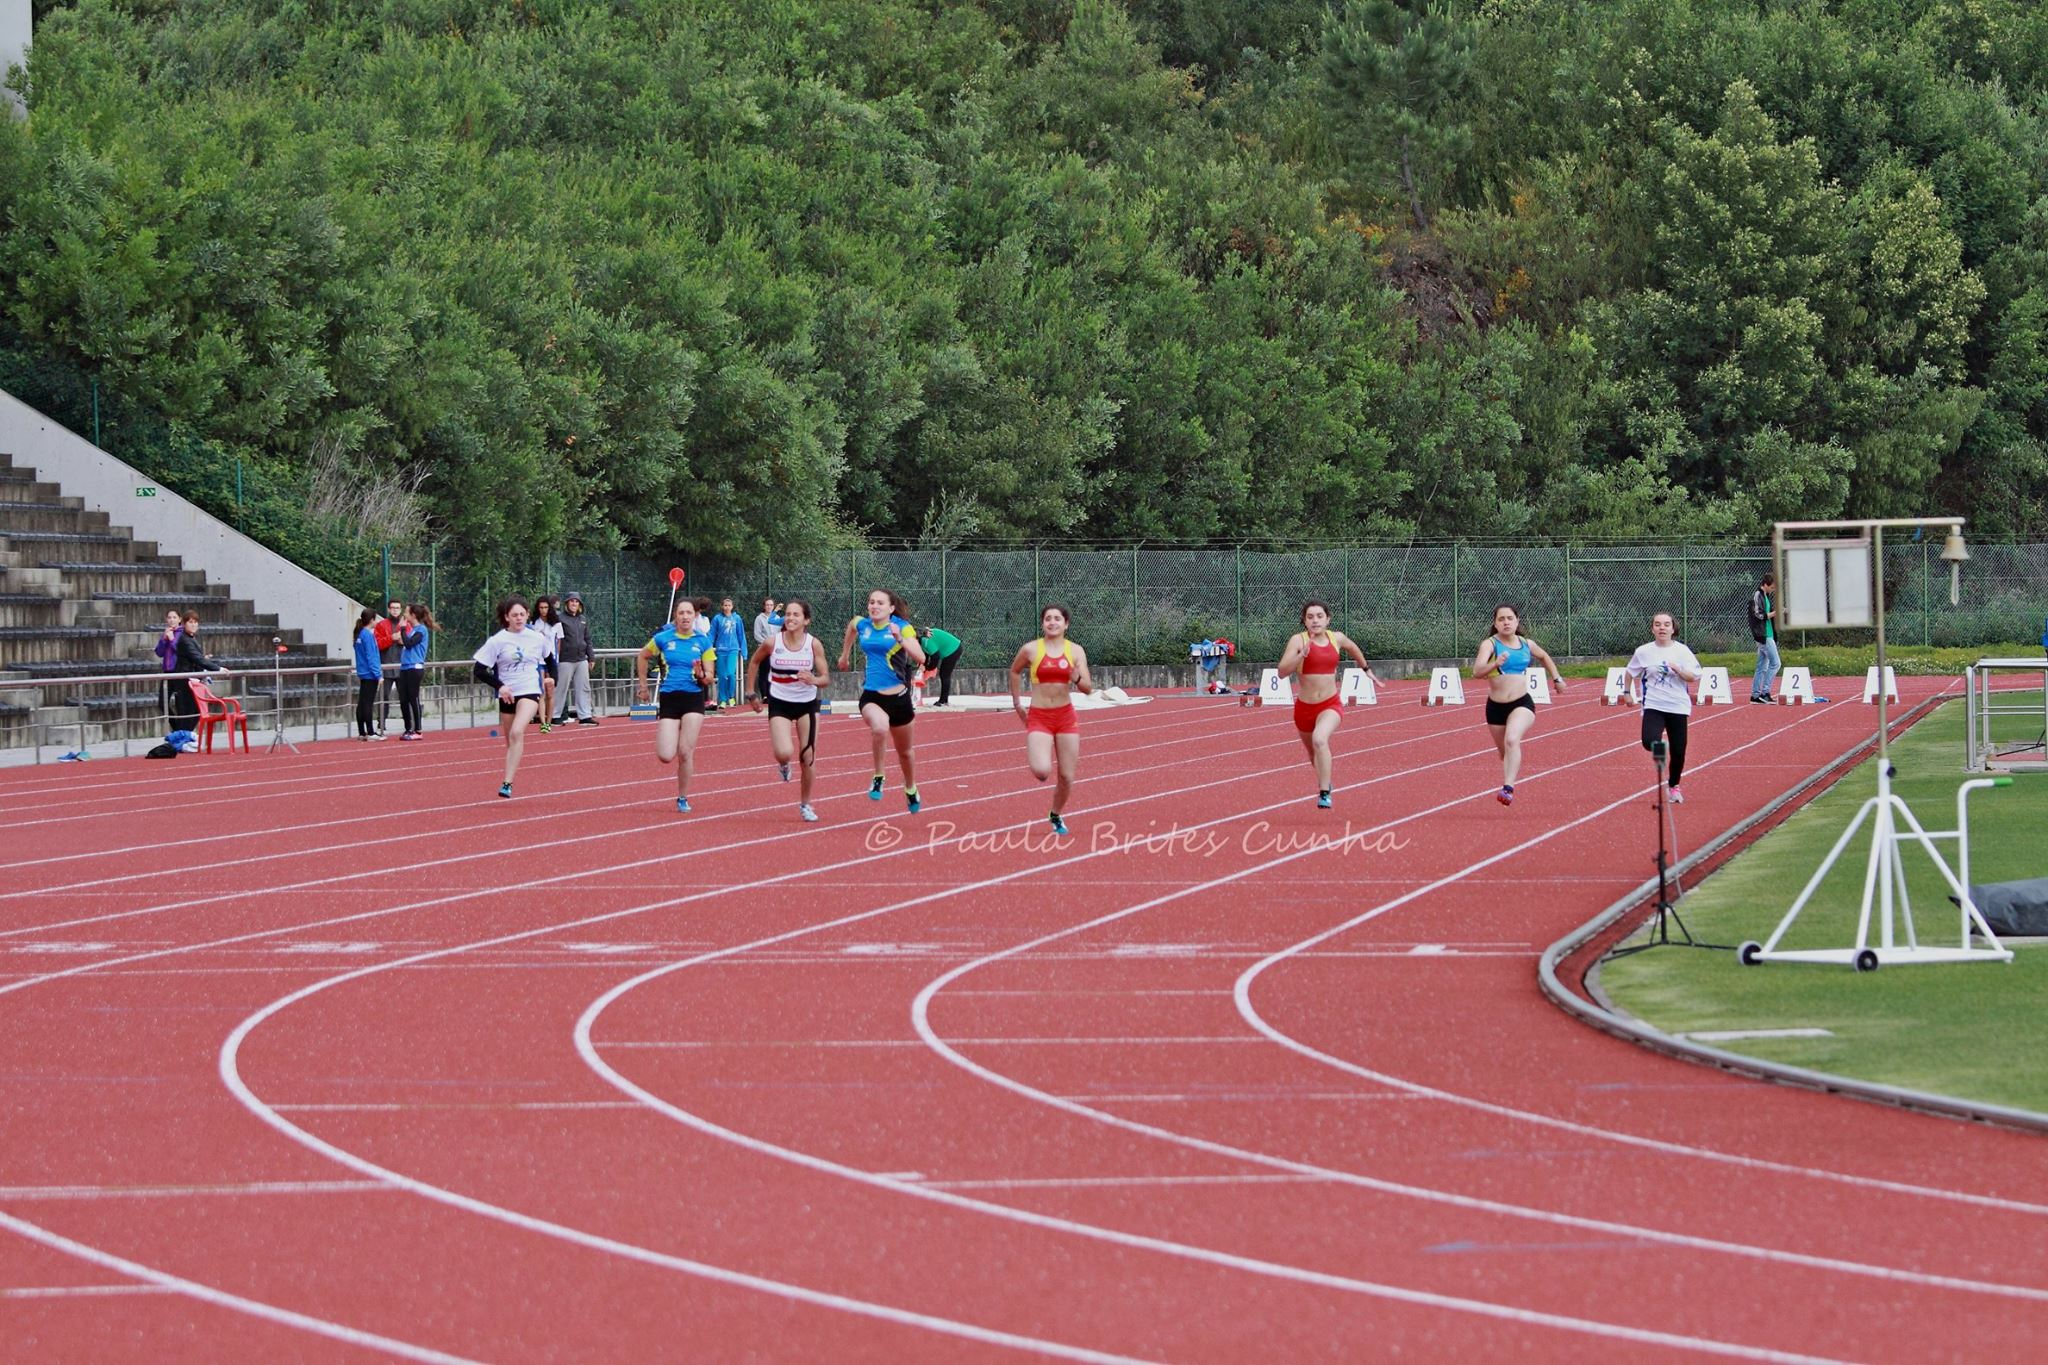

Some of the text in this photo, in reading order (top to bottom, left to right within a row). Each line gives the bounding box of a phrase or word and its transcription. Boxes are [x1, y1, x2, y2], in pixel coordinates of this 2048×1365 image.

[1271, 675, 1279, 691] 8
[1352, 675, 1360, 690] 7
[1440, 674, 1448, 690] 6
[1530, 674, 1538, 690] 5
[1616, 674, 1624, 689] 4
[1710, 674, 1718, 689] 3
[1792, 674, 1800, 689] 2
